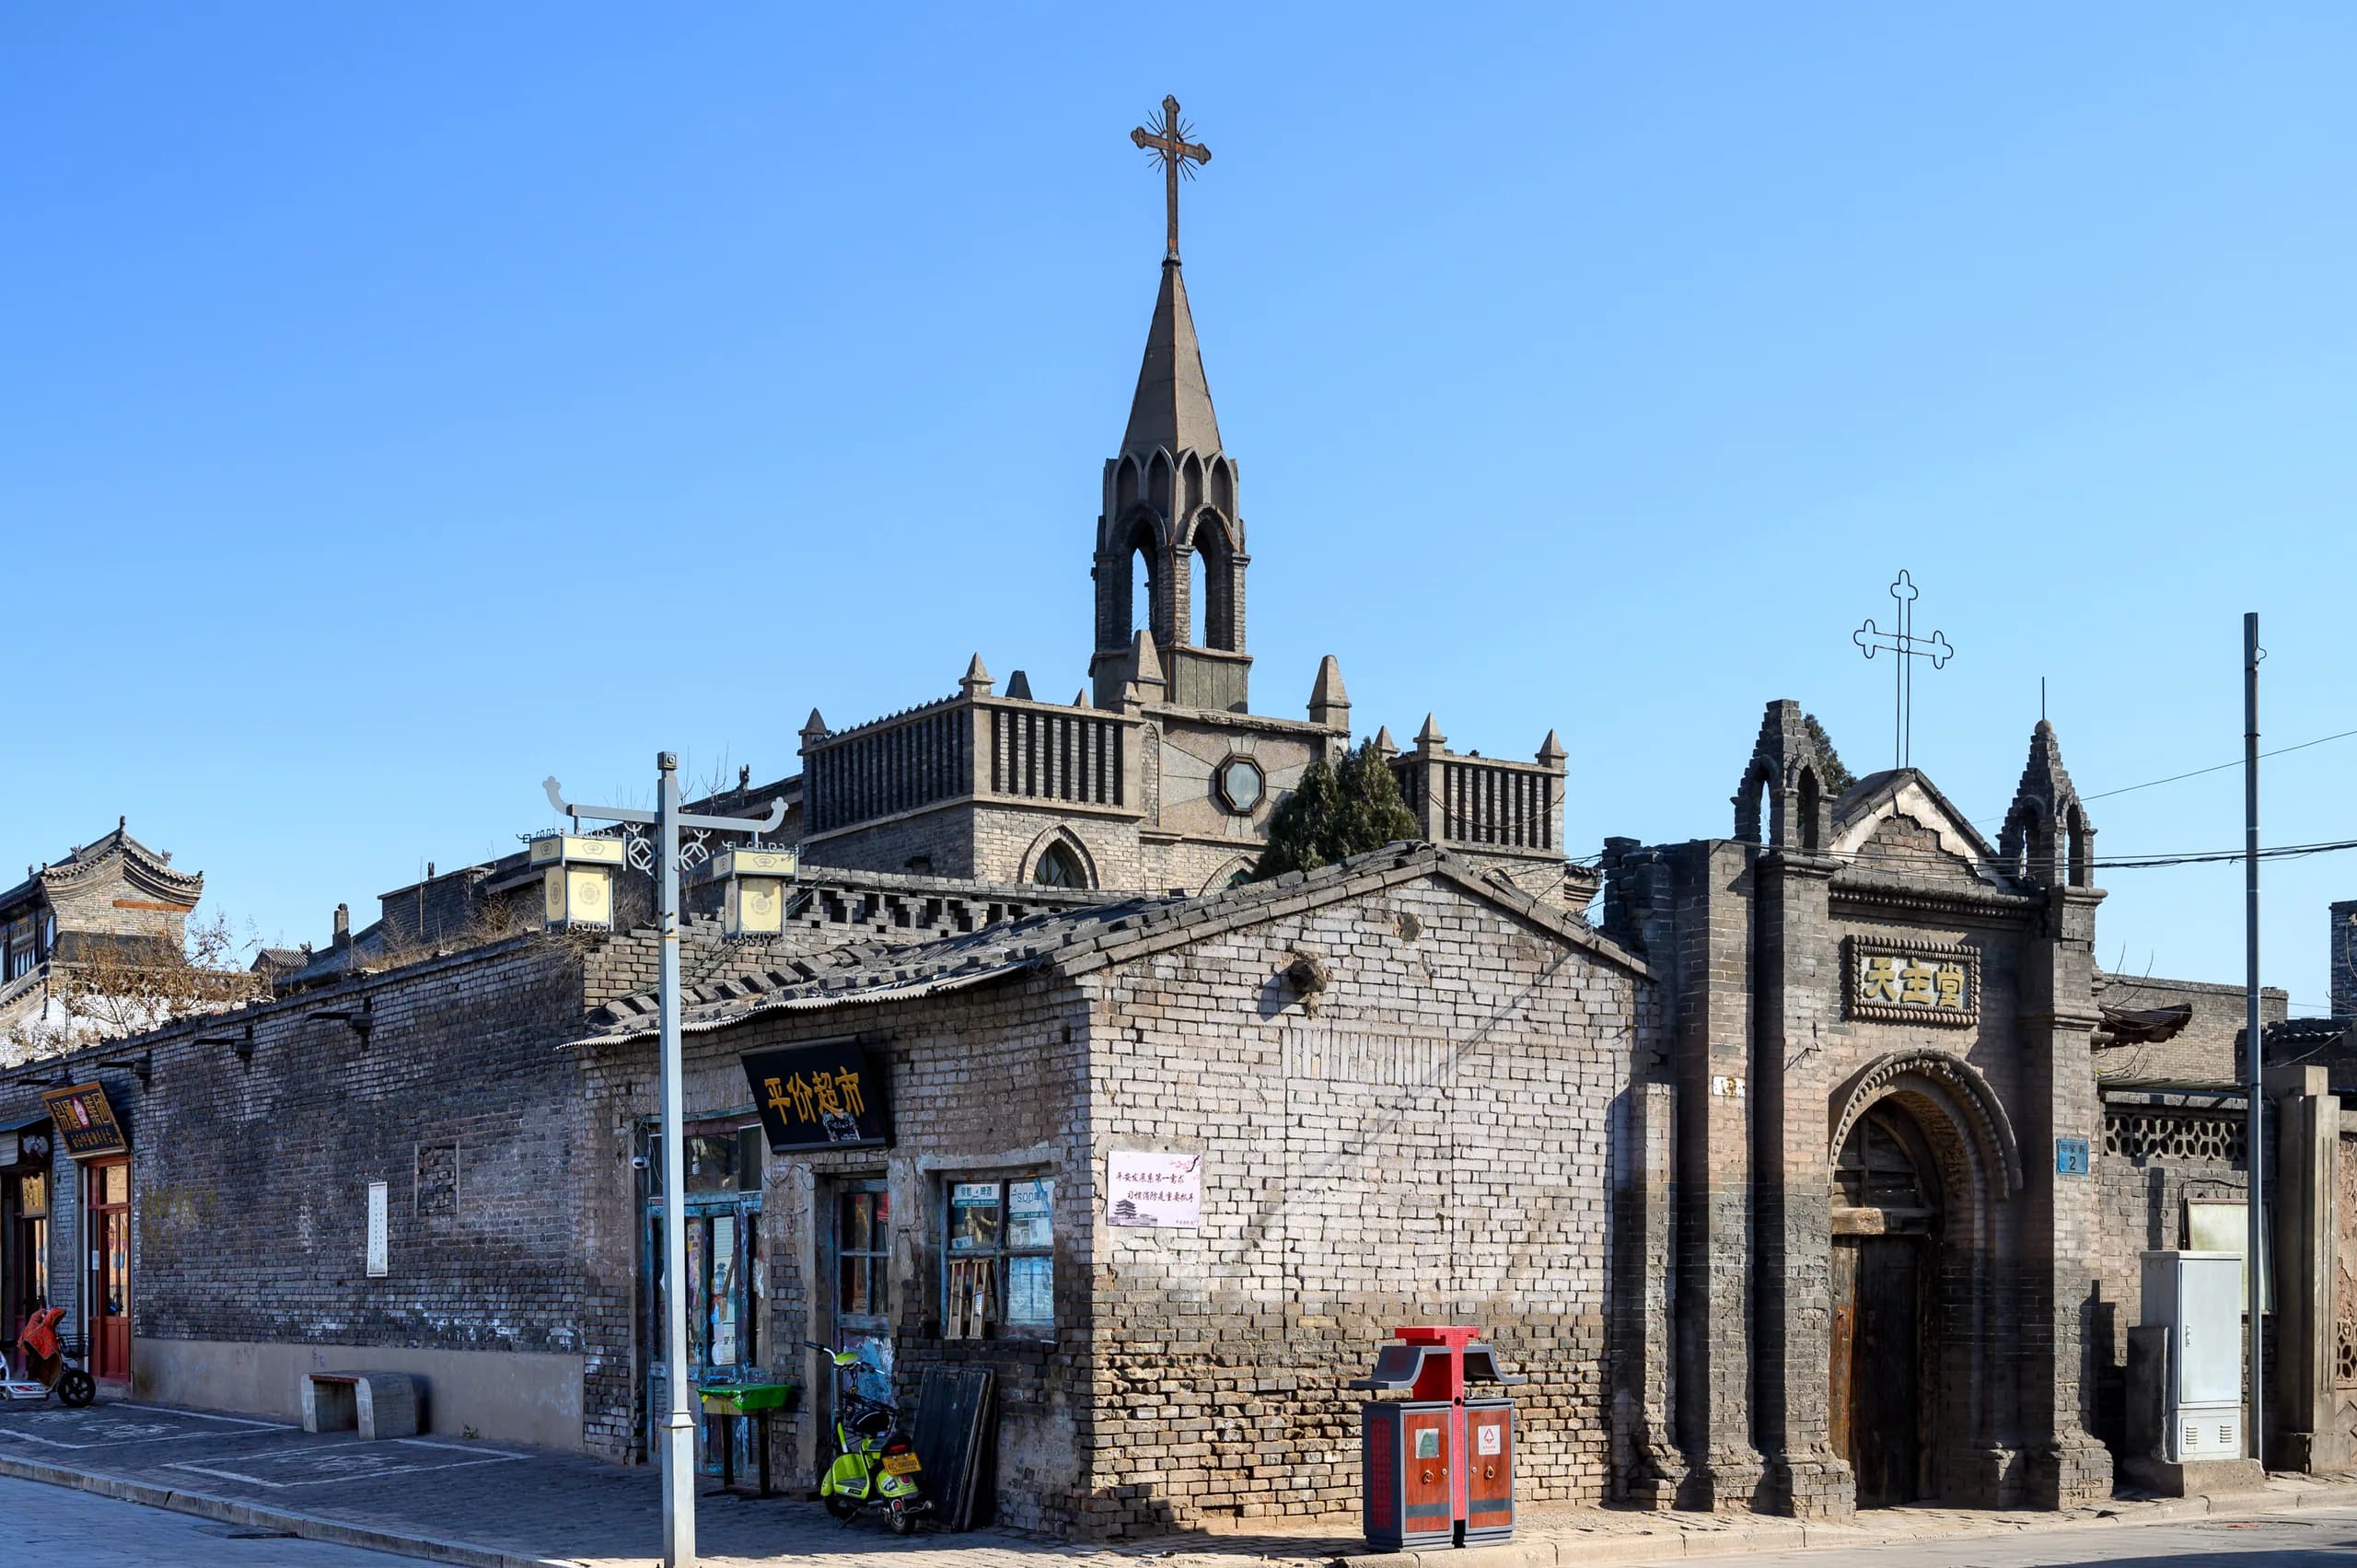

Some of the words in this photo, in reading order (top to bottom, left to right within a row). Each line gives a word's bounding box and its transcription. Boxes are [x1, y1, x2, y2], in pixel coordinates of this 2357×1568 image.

[1863, 957, 1965, 1009] 天主堂
[763, 1065, 865, 1126] 平价超市
[2069, 1156, 2076, 1170] 2
